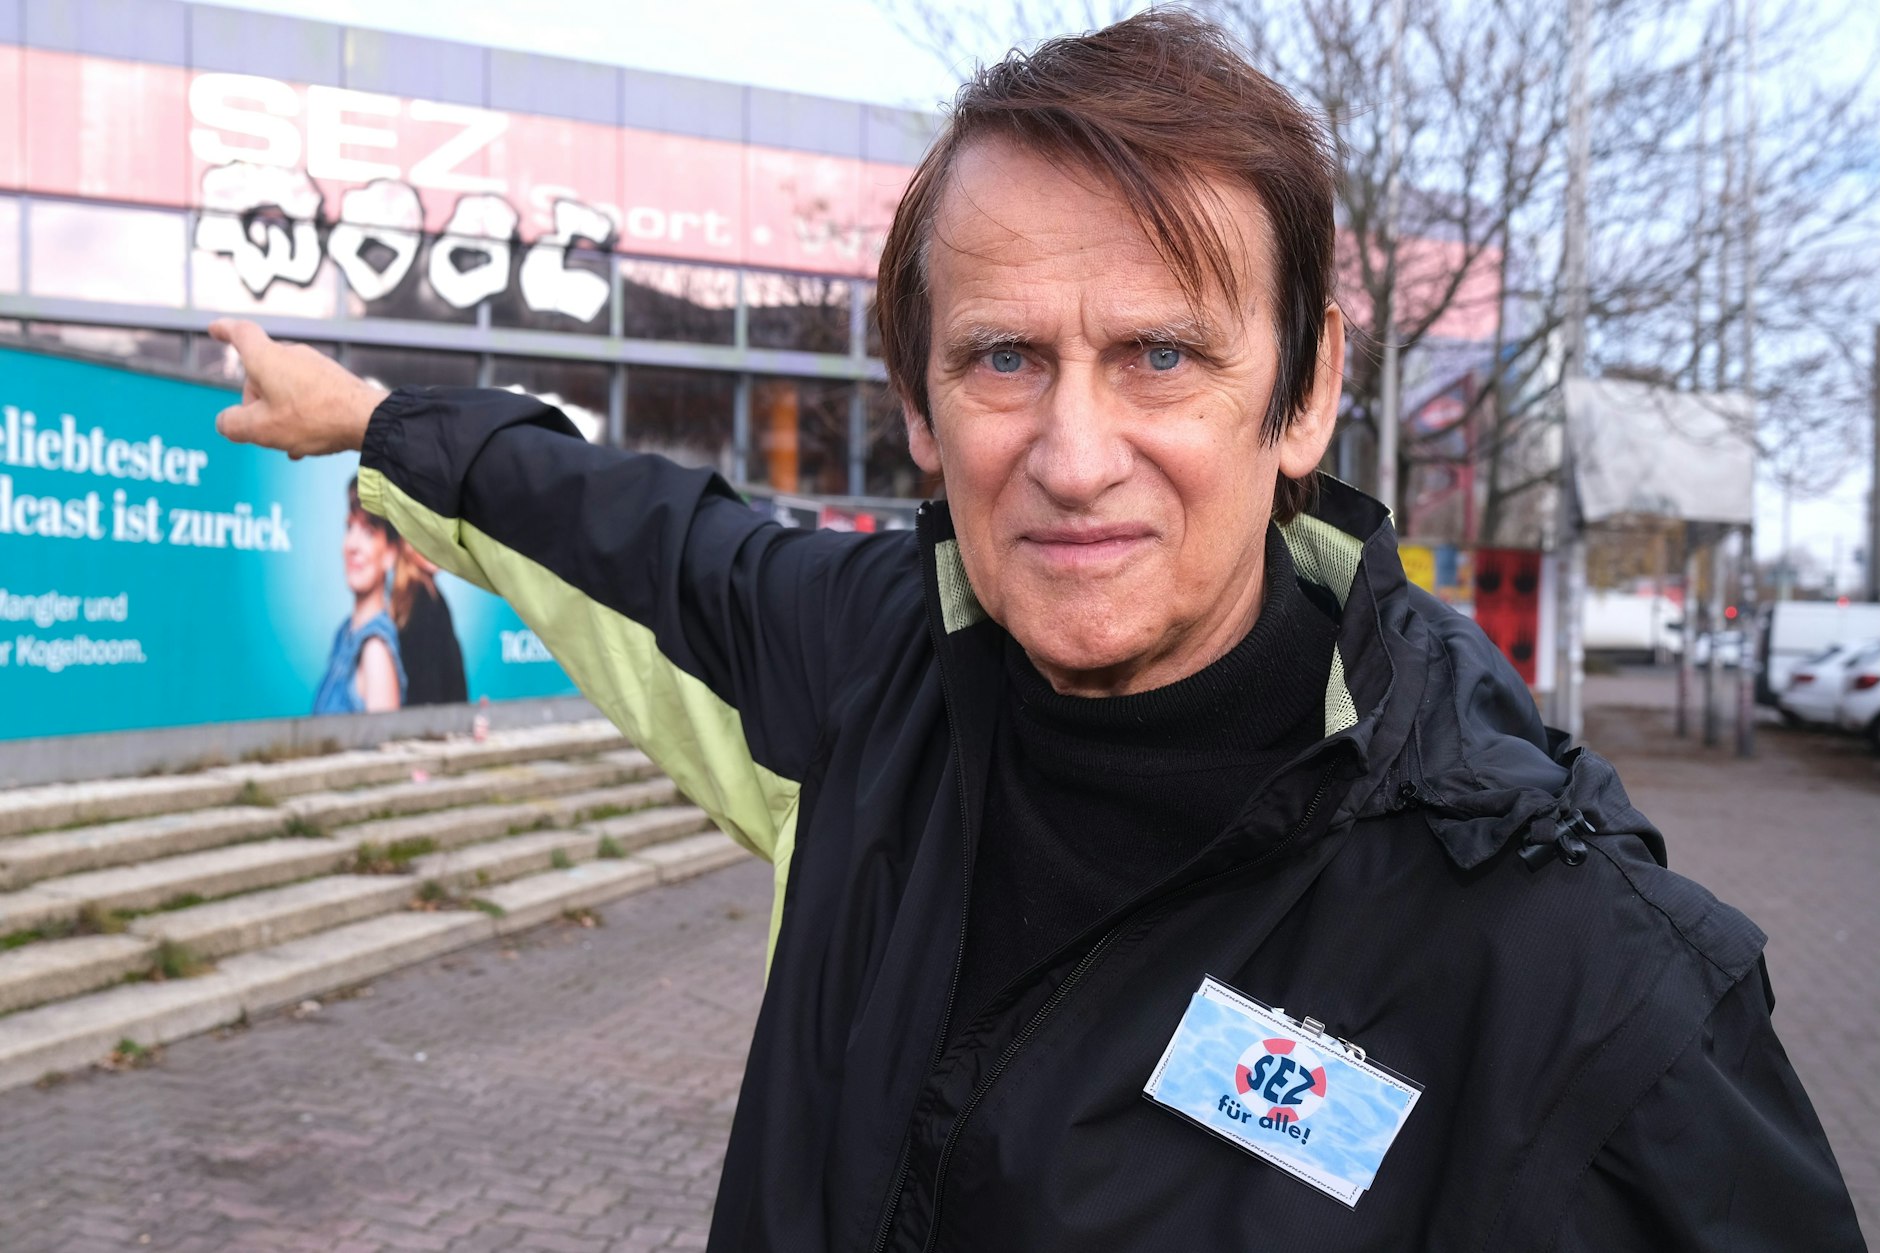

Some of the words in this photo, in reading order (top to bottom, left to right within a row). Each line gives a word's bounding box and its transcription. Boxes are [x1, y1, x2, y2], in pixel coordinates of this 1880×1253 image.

[188, 73, 509, 194] SEZ
[0, 404, 208, 486] liebtester
[112, 488, 163, 544] ist
[169, 502, 291, 552] zurück
[84, 591, 128, 622] und
[1246, 1055, 1316, 1105] SEZ
[1217, 1095, 1251, 1124] für
[1258, 1112, 1311, 1145] alle!
